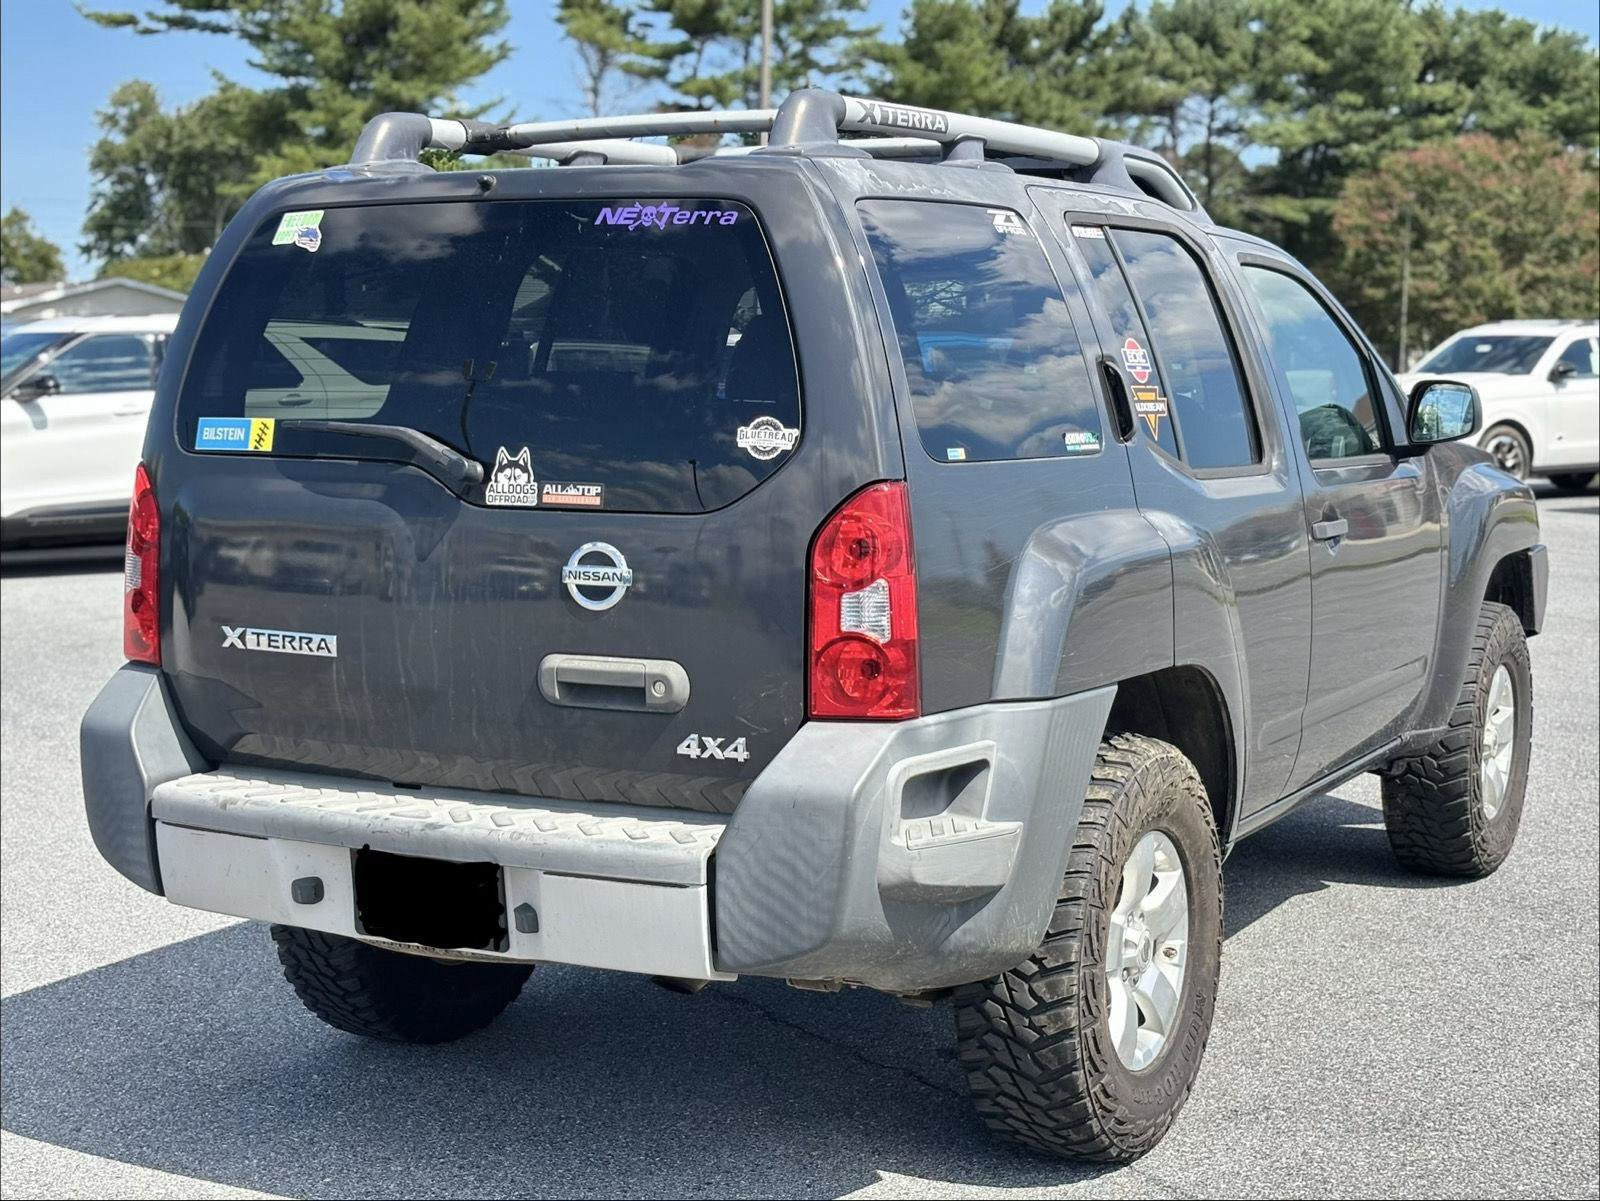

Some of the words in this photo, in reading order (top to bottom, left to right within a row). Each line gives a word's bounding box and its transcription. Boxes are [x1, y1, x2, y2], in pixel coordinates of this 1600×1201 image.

[855, 100, 949, 134] XTERRA
[202, 427, 245, 440] BILSTEIN
[739, 430, 794, 442] GLUETREAD
[488, 483, 536, 494] ALLDOGS
[487, 494, 529, 504] OFFROAD
[567, 570, 623, 583] NISSAN
[221, 625, 338, 657] XTERRA
[676, 733, 751, 763] 4X4
